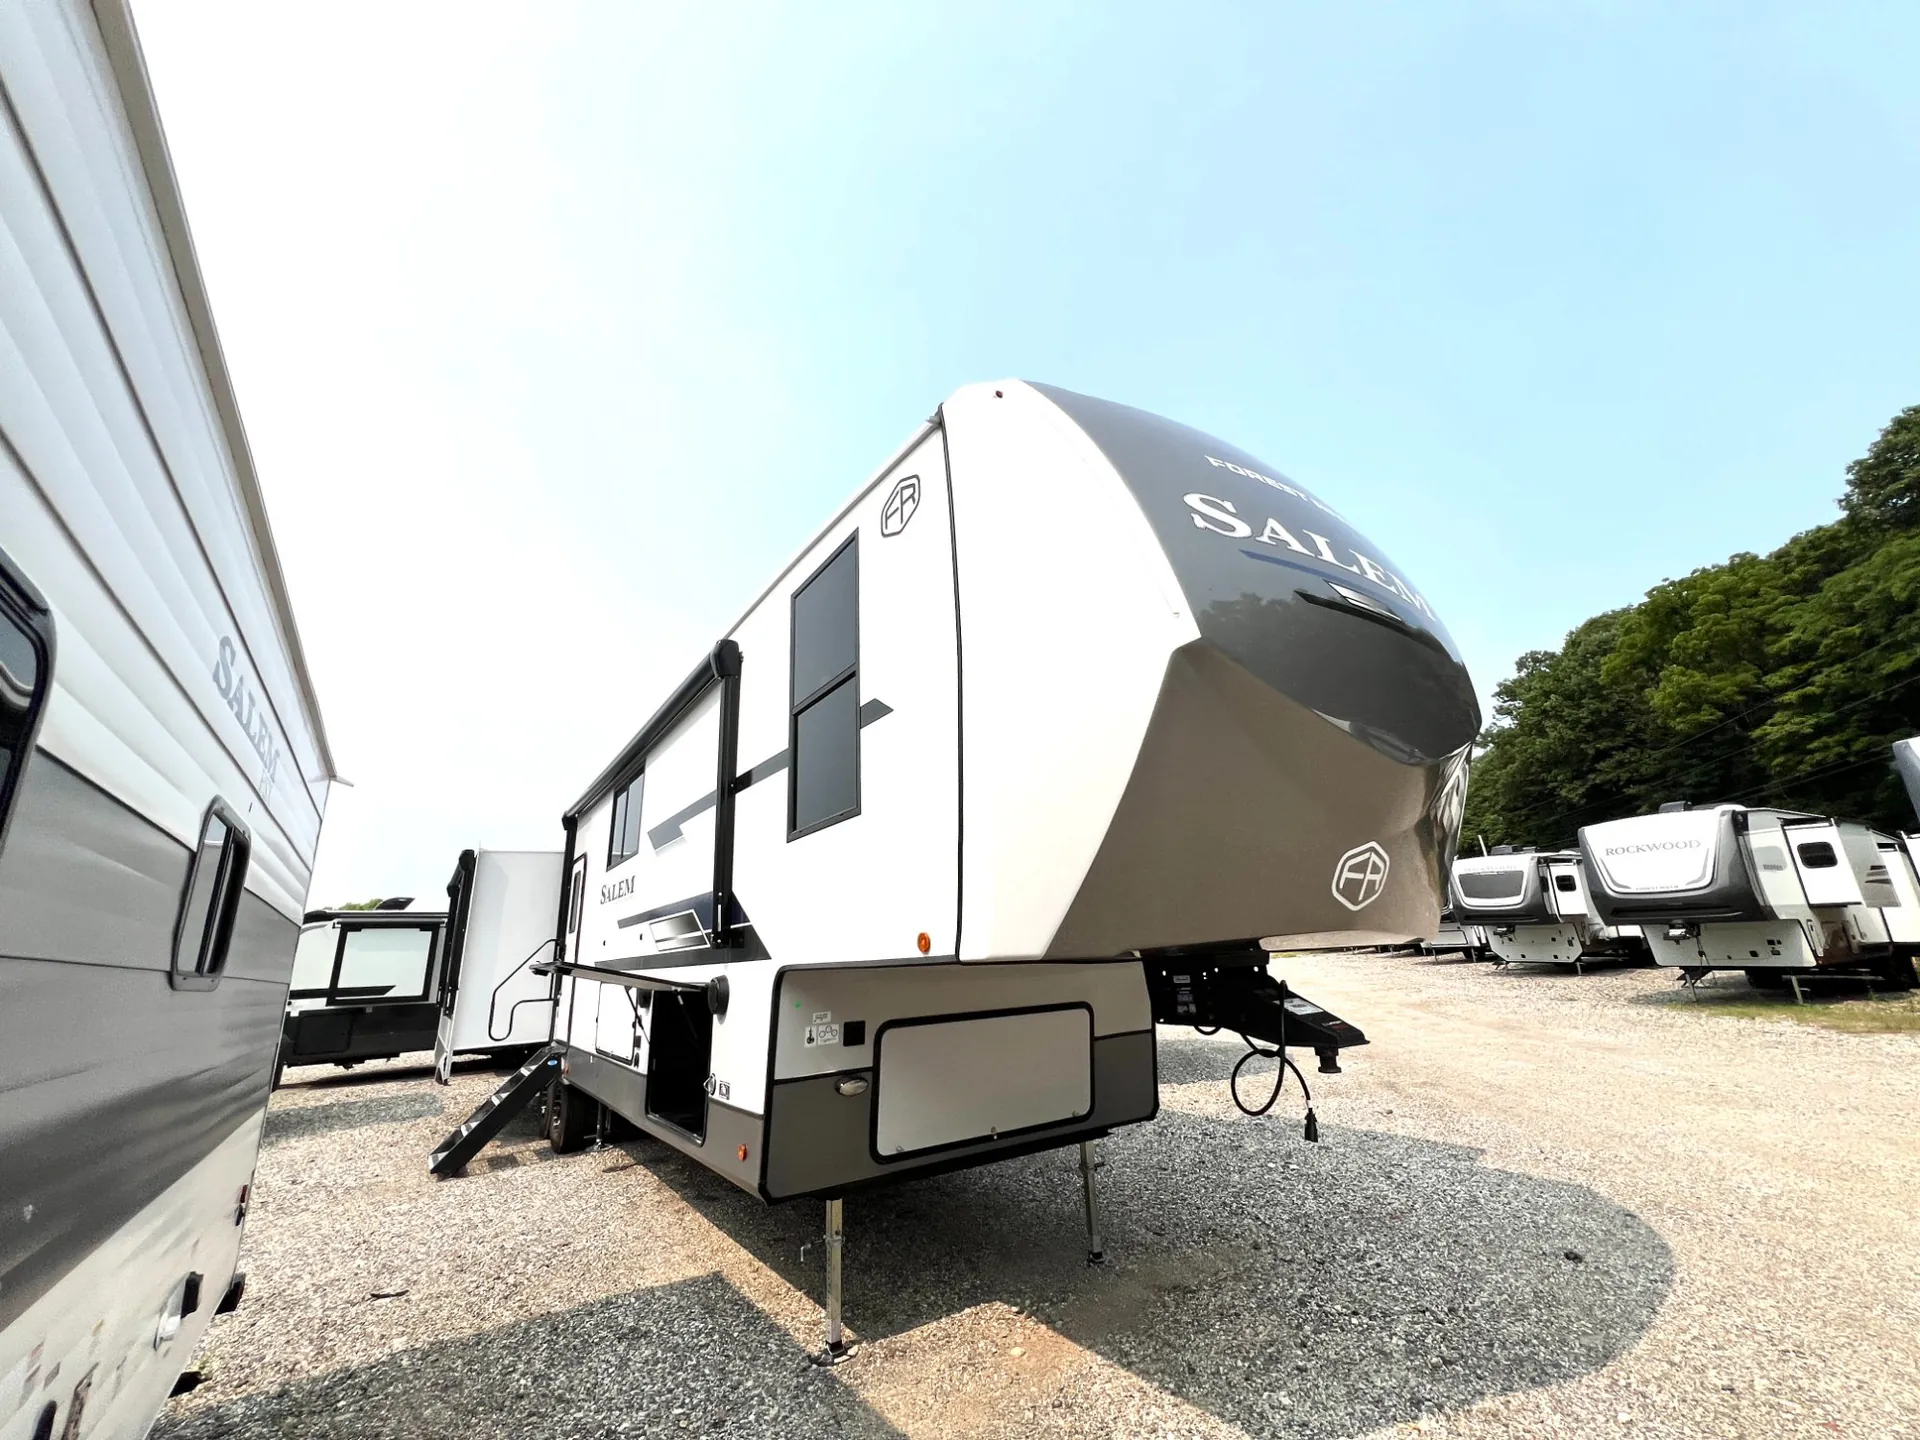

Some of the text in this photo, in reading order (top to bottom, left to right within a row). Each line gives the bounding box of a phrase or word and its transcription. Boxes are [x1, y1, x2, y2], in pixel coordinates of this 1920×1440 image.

[1183, 492, 1436, 621] SALEM
[212, 635, 280, 785] SALEM
[1605, 839, 1702, 857] ROCKWOOD
[600, 875, 636, 905] SALEM
